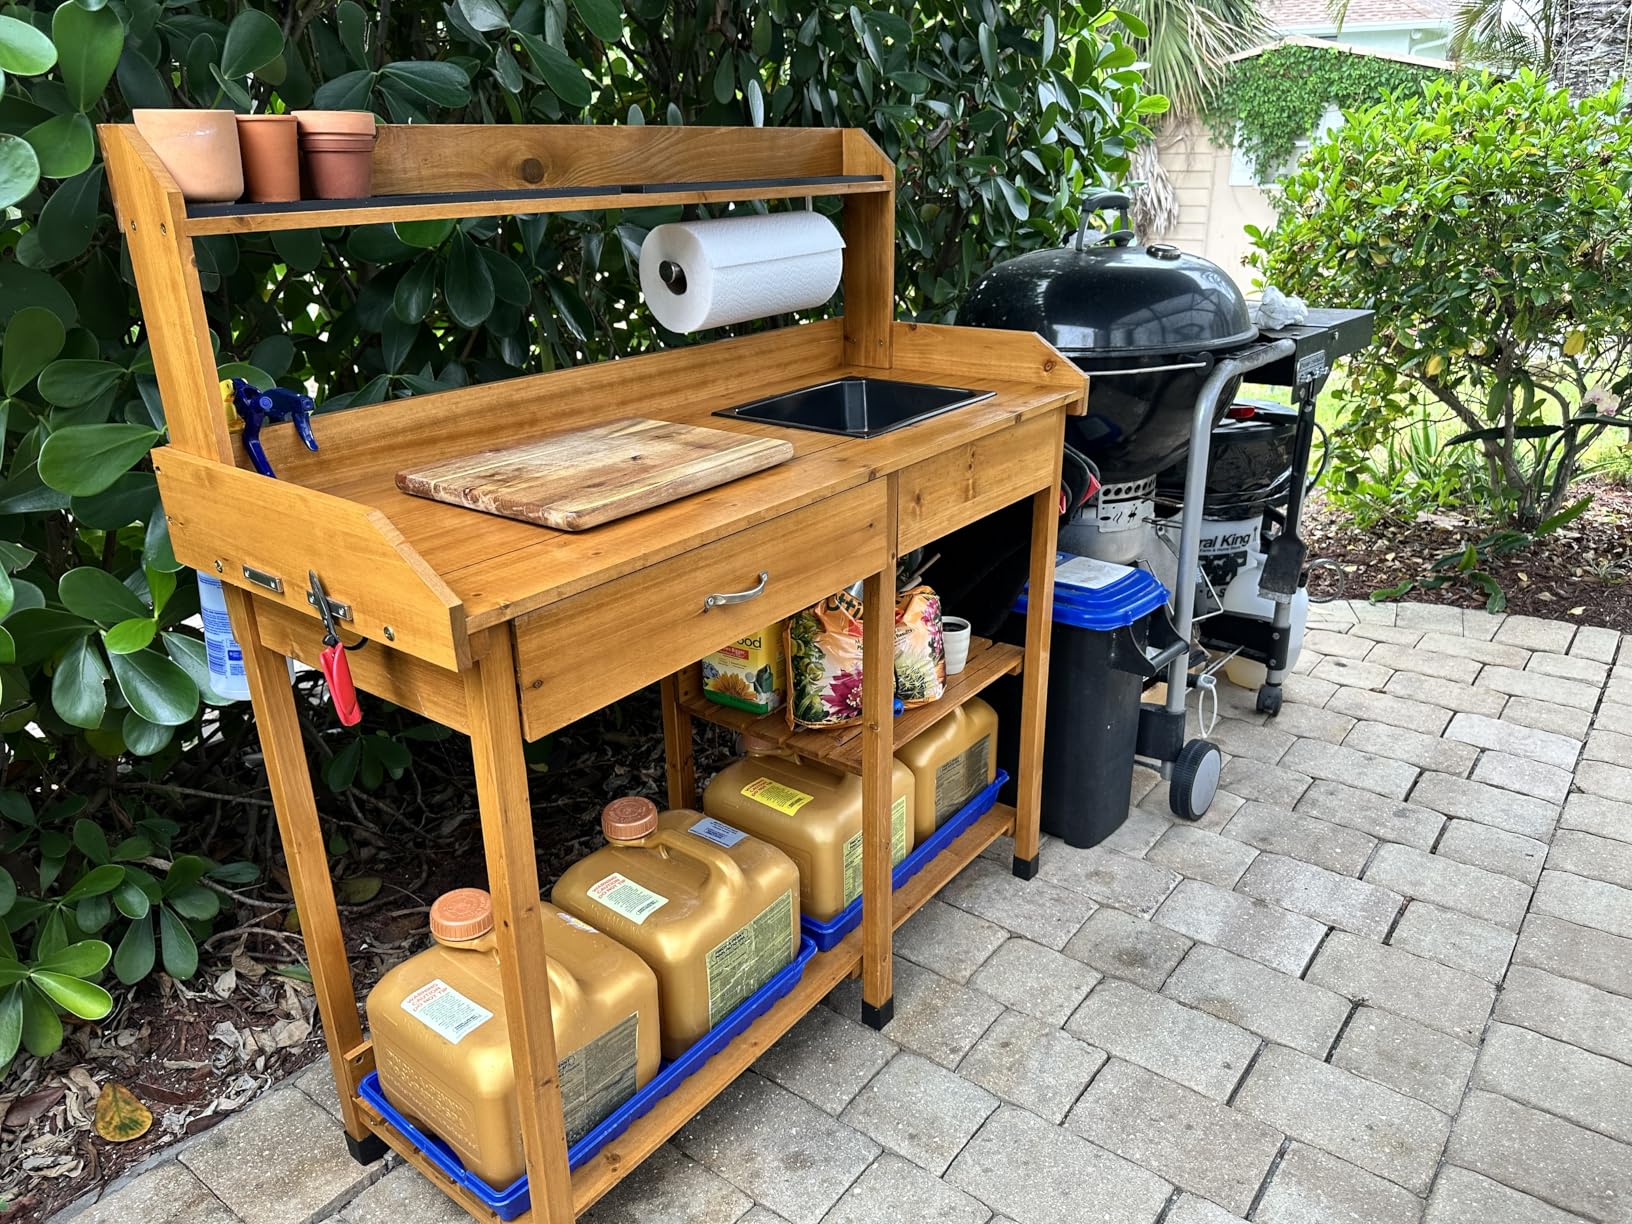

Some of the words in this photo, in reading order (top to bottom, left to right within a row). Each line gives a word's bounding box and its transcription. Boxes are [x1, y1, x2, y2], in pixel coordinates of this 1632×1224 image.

[1199, 535, 1218, 548] ral
[1220, 533, 1251, 547] King
[736, 636, 762, 649] ood
[412, 986, 442, 1006] CAUTION
[423, 994, 437, 1003] NOT
